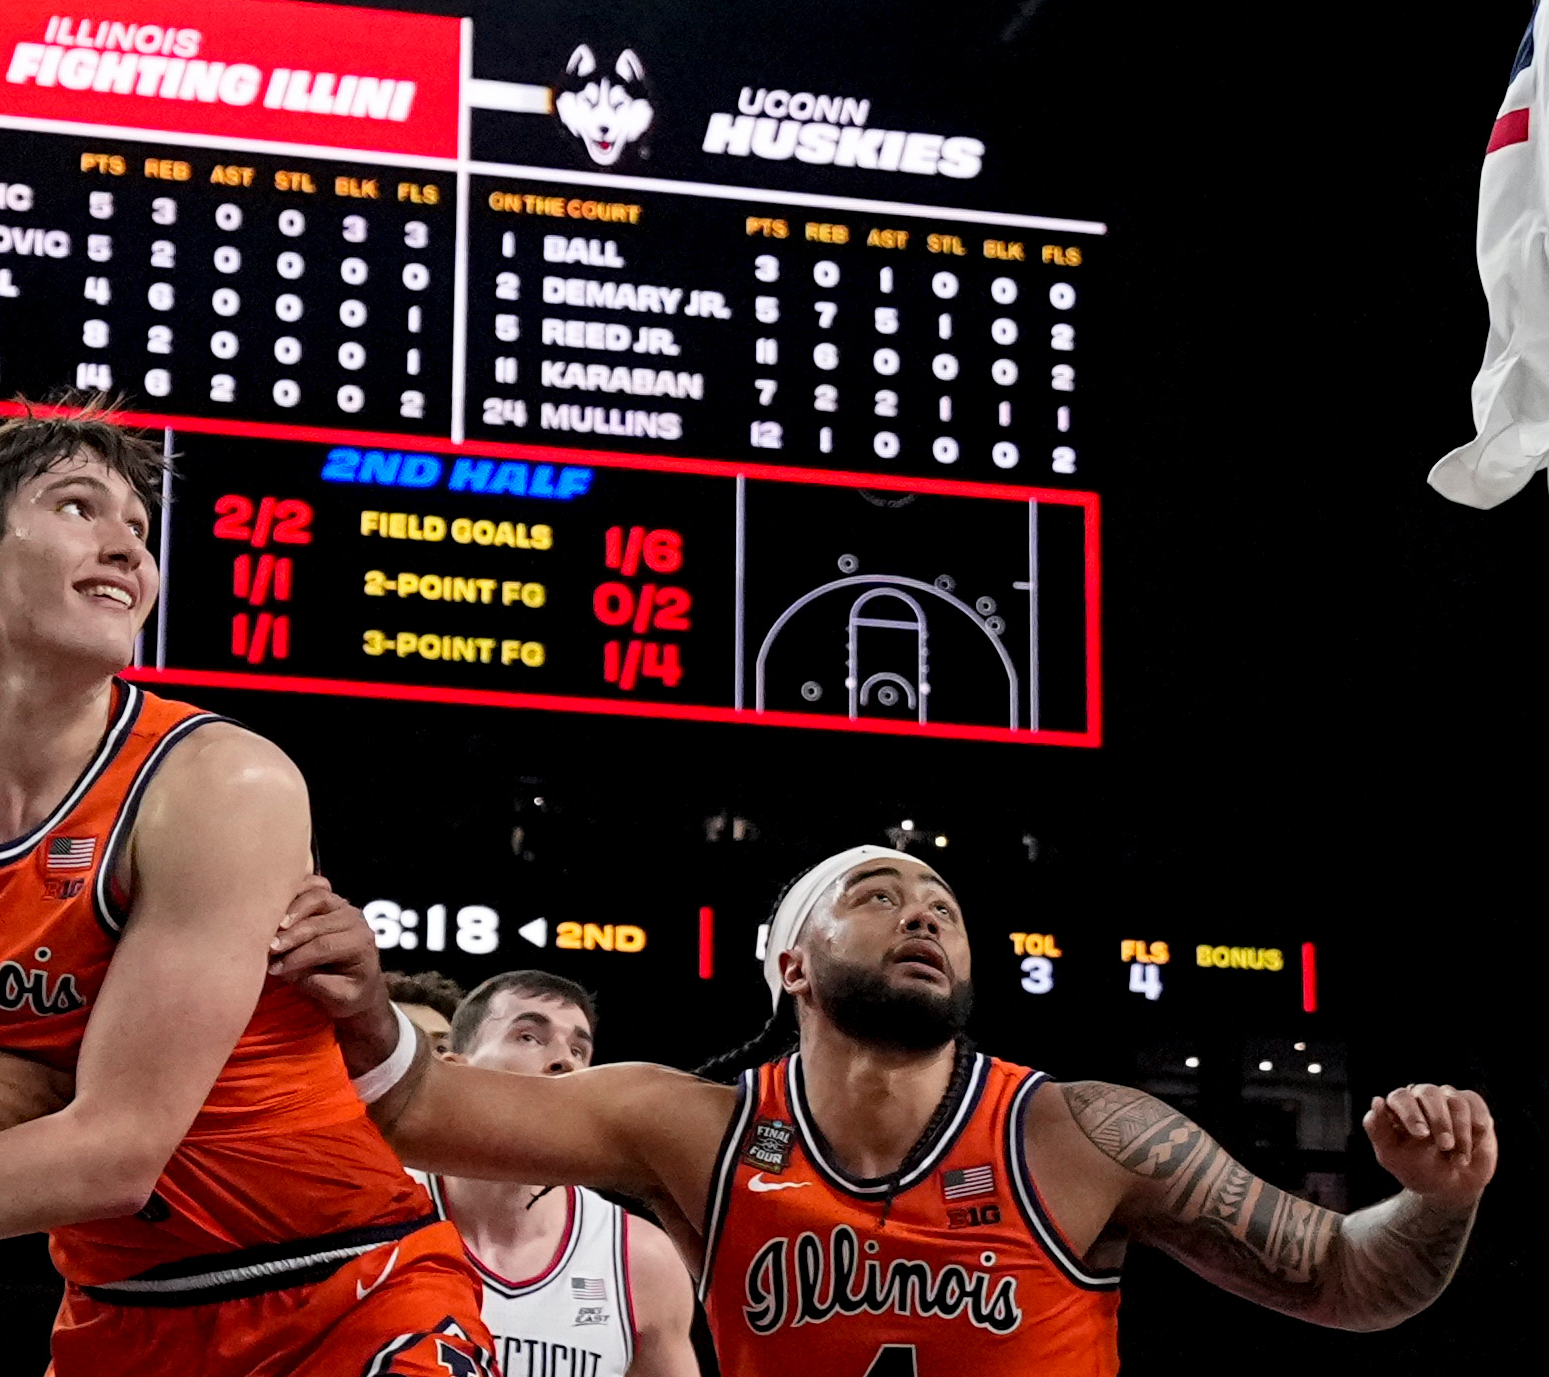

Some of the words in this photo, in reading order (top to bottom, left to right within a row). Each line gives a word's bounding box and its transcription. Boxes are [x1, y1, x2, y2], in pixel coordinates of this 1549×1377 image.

[44, 15, 202, 59] ILLINOIS
[6, 43, 260, 108] FIGHTING
[263, 68, 417, 122] ILLINI
[737, 87, 870, 126] UCONN
[702, 112, 985, 179] HUSKIES
[80, 152, 127, 176] PTS
[143, 157, 192, 182] REB
[209, 164, 255, 187] AST
[274, 169, 316, 194] STL
[334, 176, 379, 199] BLK
[397, 182, 440, 205] FLS
[88, 190, 114, 220] 5
[151, 197, 177, 225] 3
[215, 202, 243, 232] 0
[278, 208, 306, 237] 0
[342, 214, 368, 243] 3
[403, 220, 429, 249] 3
[488, 191, 523, 214] ON
[521, 194, 566, 218] THE
[565, 198, 642, 224] COURT
[87, 233, 113, 263] 5
[150, 239, 177, 269] 2
[213, 245, 242, 274] 0
[276, 251, 305, 280] 0
[340, 257, 369, 286] 0
[401, 262, 430, 291] 0
[745, 216, 789, 239] PTS
[804, 221, 850, 244] REB
[866, 228, 910, 249] AST
[926, 233, 966, 256] STL
[982, 239, 1024, 261] BLK
[1041, 244, 1082, 267] FLS
[501, 230, 516, 258] 1
[543, 234, 625, 269] BALL
[754, 254, 780, 283] 3
[813, 260, 841, 288] 0
[879, 266, 894, 294] 1
[931, 270, 959, 300] 0
[990, 276, 1018, 305] 0
[1049, 282, 1077, 311] 0
[83, 276, 112, 306] 4
[211, 287, 241, 317] 0
[275, 293, 304, 323] 0
[339, 298, 368, 328] 0
[407, 305, 422, 333] 1
[495, 271, 521, 301] 2
[542, 275, 684, 315] DEMARY
[683, 289, 732, 320] JR.
[754, 295, 780, 324] 5
[813, 301, 838, 329] 7
[874, 306, 899, 335] 5
[938, 312, 952, 340] 1
[991, 317, 1019, 346] 0
[1050, 322, 1075, 351] 2
[146, 324, 173, 355] 2
[210, 330, 239, 360] 0
[273, 336, 302, 365] 0
[337, 341, 367, 371] 0
[406, 348, 421, 376] 1
[494, 313, 520, 342] 5
[541, 317, 632, 352] REED
[632, 326, 681, 357] JR.
[755, 337, 778, 366] 11
[872, 347, 901, 376] 0
[931, 353, 959, 381] 0
[991, 358, 1019, 386] 0
[1051, 363, 1075, 392] 2
[209, 373, 236, 403] 2
[272, 378, 301, 408] 0
[336, 384, 365, 413] 0
[399, 389, 425, 419] 2
[494, 356, 518, 384] 11
[541, 360, 704, 400] KARABAN
[754, 378, 778, 406] 7
[813, 383, 838, 413] 2
[874, 389, 898, 418] 2
[1056, 405, 1070, 433] 1
[482, 397, 528, 428] 24
[540, 402, 683, 441] MULLINS
[750, 420, 783, 449] 12
[819, 426, 833, 454] 1
[873, 430, 901, 459] 0
[932, 436, 960, 464] 0
[991, 441, 1019, 469] 0
[1051, 446, 1076, 474] 2
[321, 446, 441, 488] 2ND
[448, 457, 593, 499] HALF
[212, 494, 313, 547] 2/2
[360, 510, 446, 542] FIELD
[451, 517, 552, 550] GOALS
[604, 524, 683, 577] 1/6
[232, 553, 292, 605] 1/1
[364, 570, 496, 604] 2-POINT
[502, 580, 546, 608] FG
[592, 580, 691, 633] 0/2
[231, 612, 290, 664] 1/1
[363, 629, 495, 663] 3-POINT
[501, 639, 545, 667] FG
[603, 639, 683, 690] 1/4
[556, 921, 646, 953] 2ND
[1010, 932, 1061, 958] TOL
[1121, 940, 1170, 964] FLS
[1196, 944, 1285, 972] BONUS
[1020, 957, 1054, 995] 3
[1128, 962, 1163, 1001] 4
[749, 1145, 782, 1164] FOUR
[757, 1125, 790, 1143] FINAL
[743, 1224, 1022, 1335] Illinois
